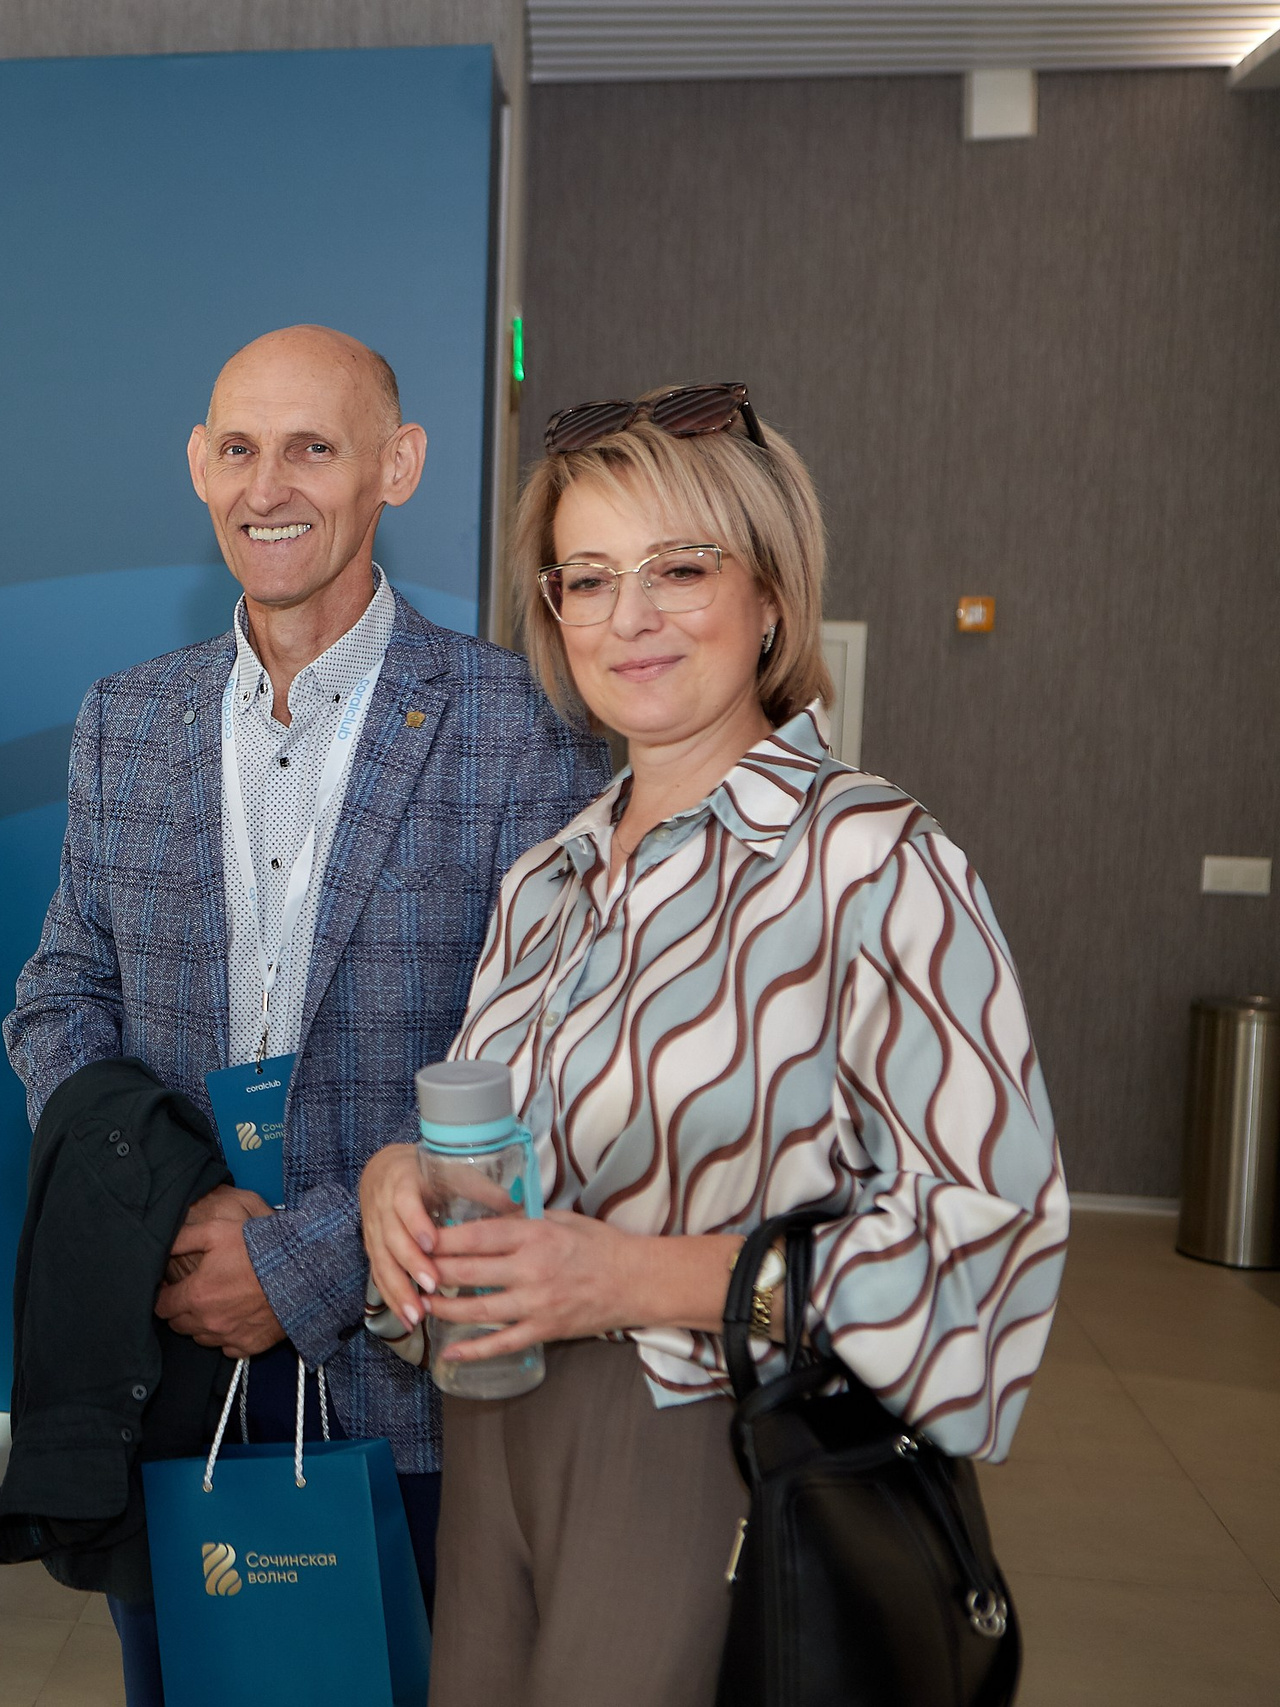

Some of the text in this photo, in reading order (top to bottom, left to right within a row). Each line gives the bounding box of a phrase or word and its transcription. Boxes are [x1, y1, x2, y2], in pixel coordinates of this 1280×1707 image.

[222, 678, 235, 740] coralclub
[337, 679, 370, 740] coralclub
[245, 1080, 282, 1093] coralclub
[245, 1551, 337, 1568] Сочинская
[247, 1570, 298, 1584] волна
